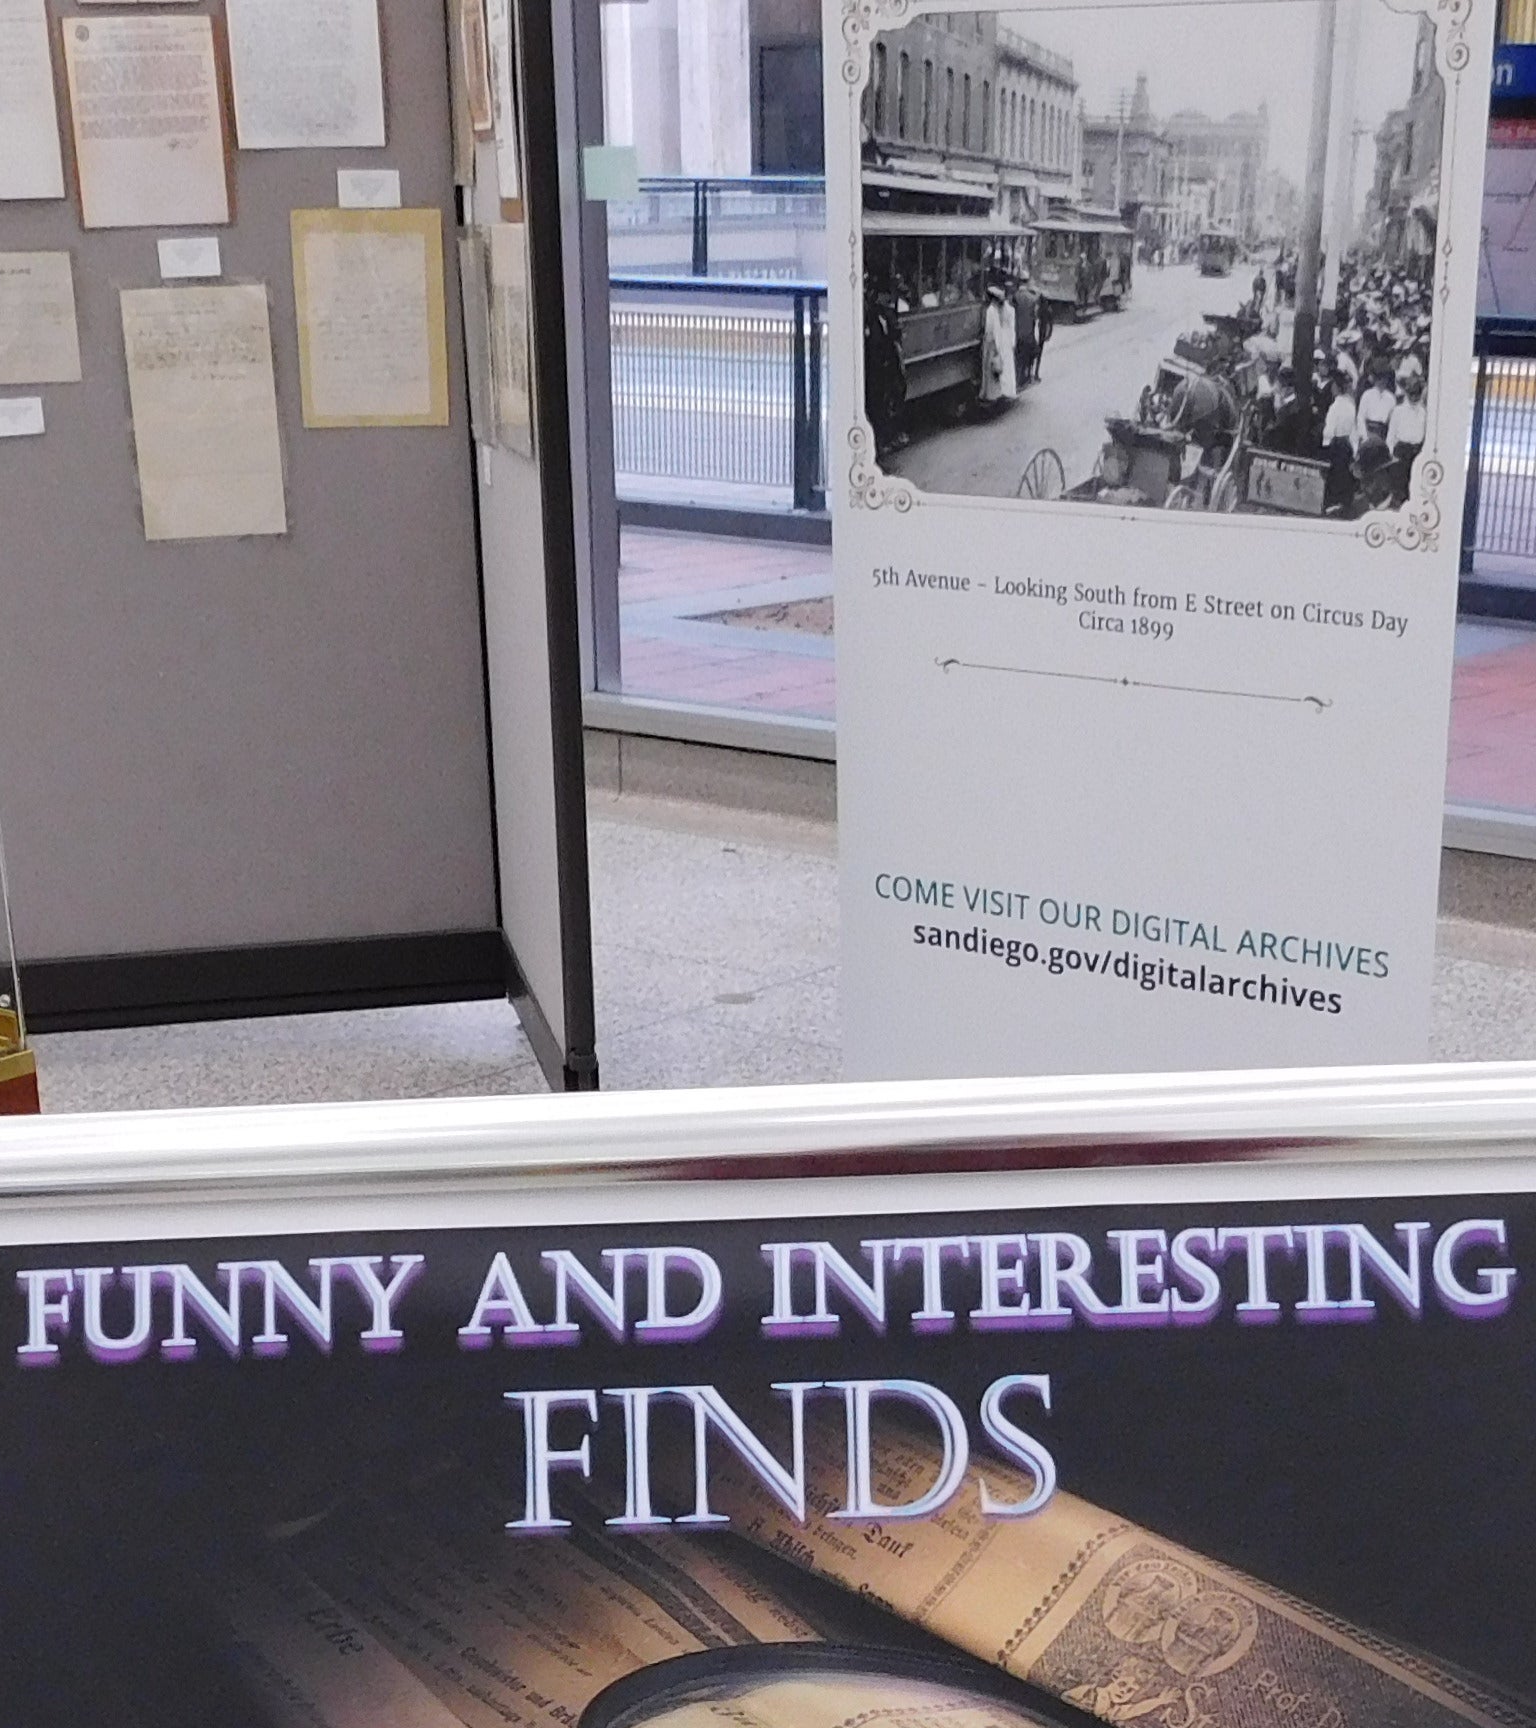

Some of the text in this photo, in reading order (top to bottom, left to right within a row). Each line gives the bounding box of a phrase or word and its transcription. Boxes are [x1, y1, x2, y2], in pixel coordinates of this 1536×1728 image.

[871, 565, 900, 588] 5th
[905, 568, 971, 592] Avenue
[994, 573, 1068, 604] Looking
[1073, 580, 1128, 608] South
[1131, 583, 1178, 611] from
[1184, 591, 1199, 613] E
[1203, 592, 1265, 619] Street
[1269, 603, 1296, 622] on
[1301, 601, 1364, 628] Circus
[1370, 608, 1409, 637] Day
[1078, 610, 1176, 641] Circa 1899
[874, 871, 1392, 980] COME VISIT OUR DIGITAL ARCHIVES
[911, 919, 1344, 1016] sandiego.gov/digitalarchives
[13, 1216, 1519, 1362] FUNNY AND INTERESTING
[502, 1374, 1059, 1534] FINDS
